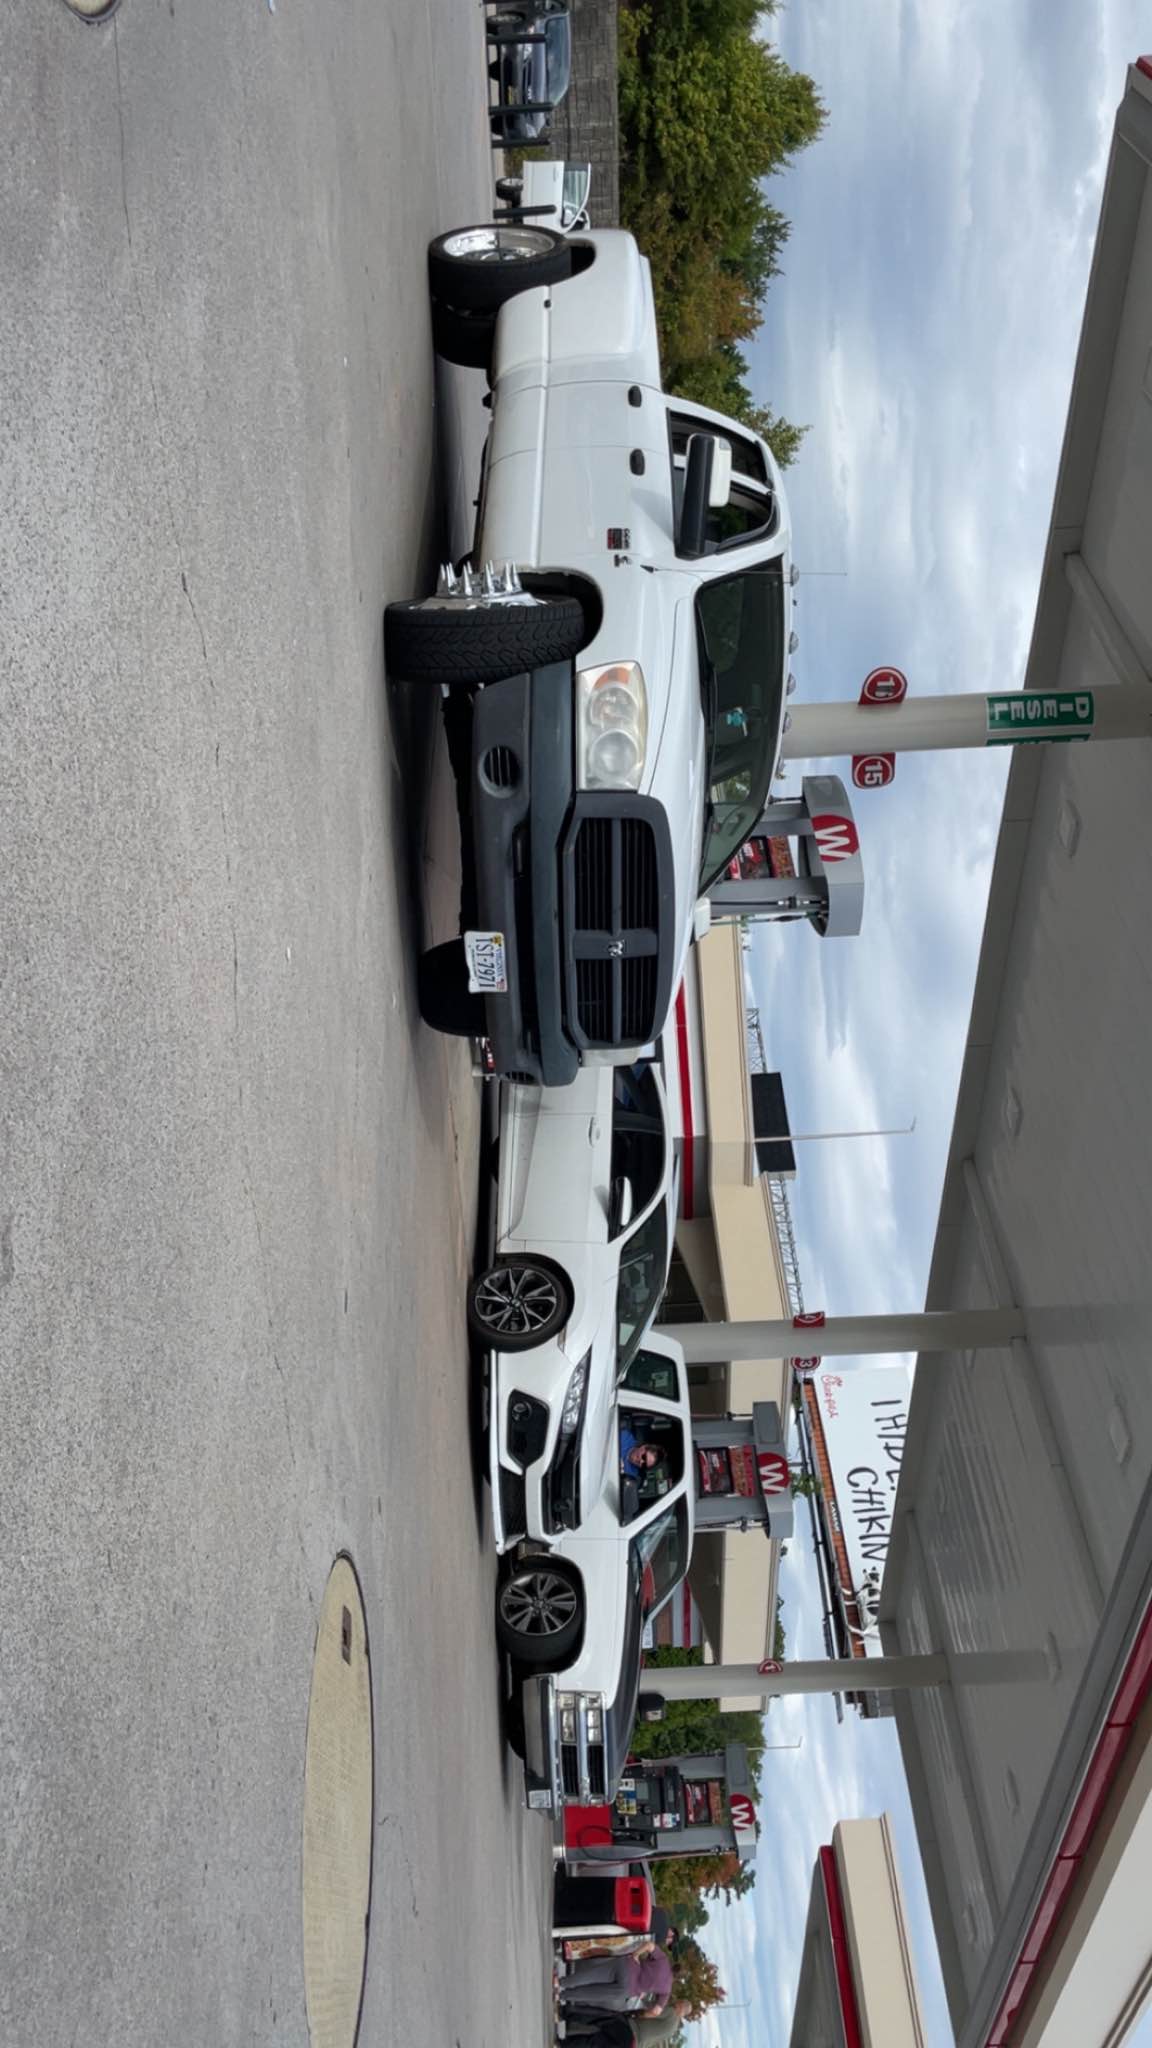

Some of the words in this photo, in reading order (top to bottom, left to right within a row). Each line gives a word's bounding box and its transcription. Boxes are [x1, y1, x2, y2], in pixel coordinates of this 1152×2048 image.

[994, 696, 1090, 720] DIESEL
[864, 761, 884, 785] 15
[813, 824, 853, 857] W
[758, 1462, 786, 1492] W
[846, 1467, 891, 1562] CHIKIN
[731, 1803, 751, 1828] W
